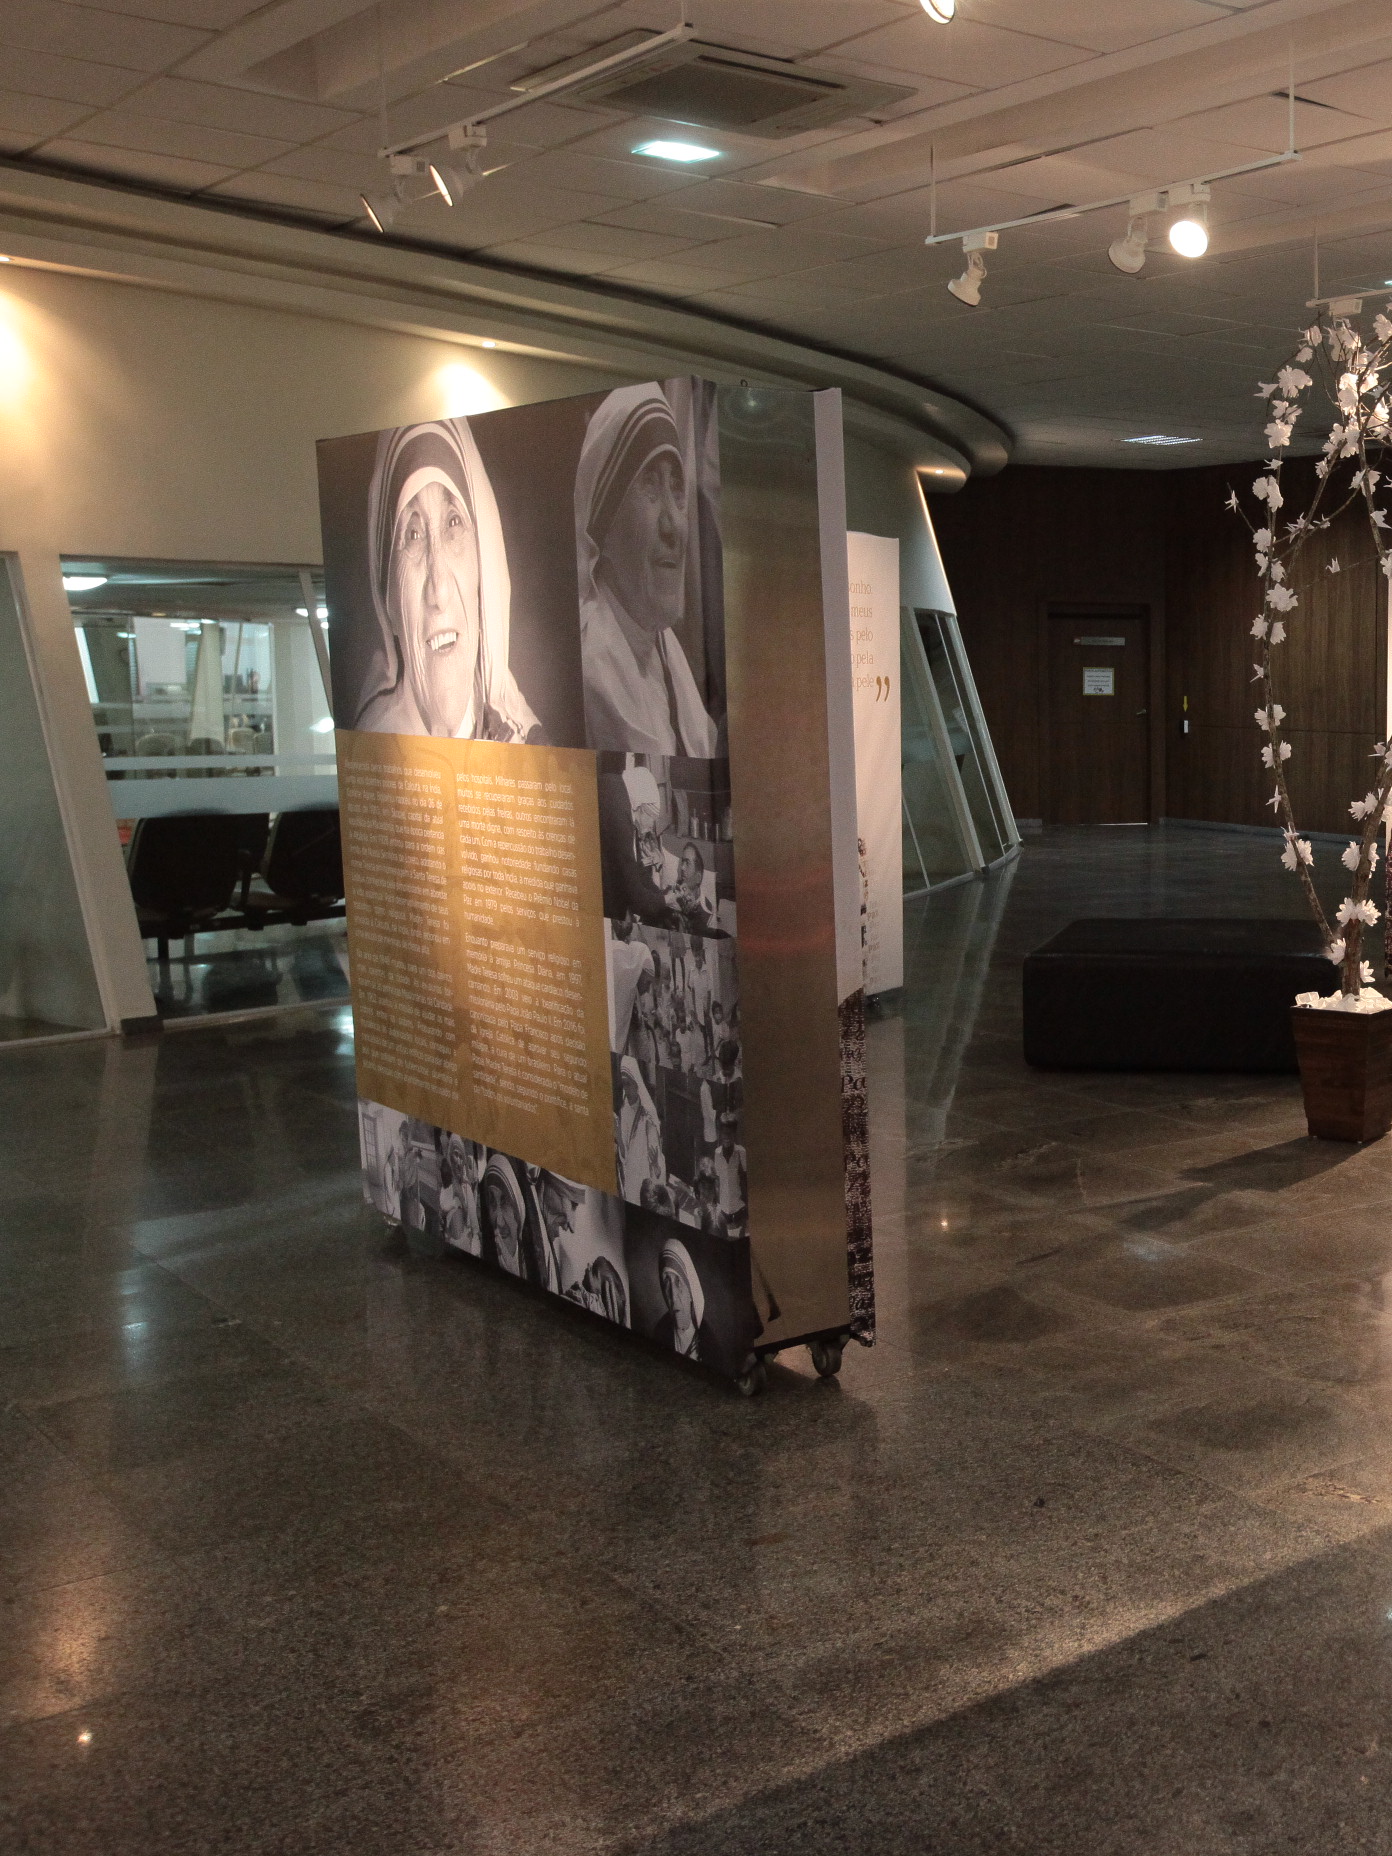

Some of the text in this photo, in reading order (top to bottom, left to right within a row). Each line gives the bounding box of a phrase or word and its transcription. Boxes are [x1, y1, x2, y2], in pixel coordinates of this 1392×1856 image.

[851, 606, 873, 618] meus
[856, 627, 874, 644] pelo
[856, 651, 874, 668] pela
[856, 674, 875, 691] pele
